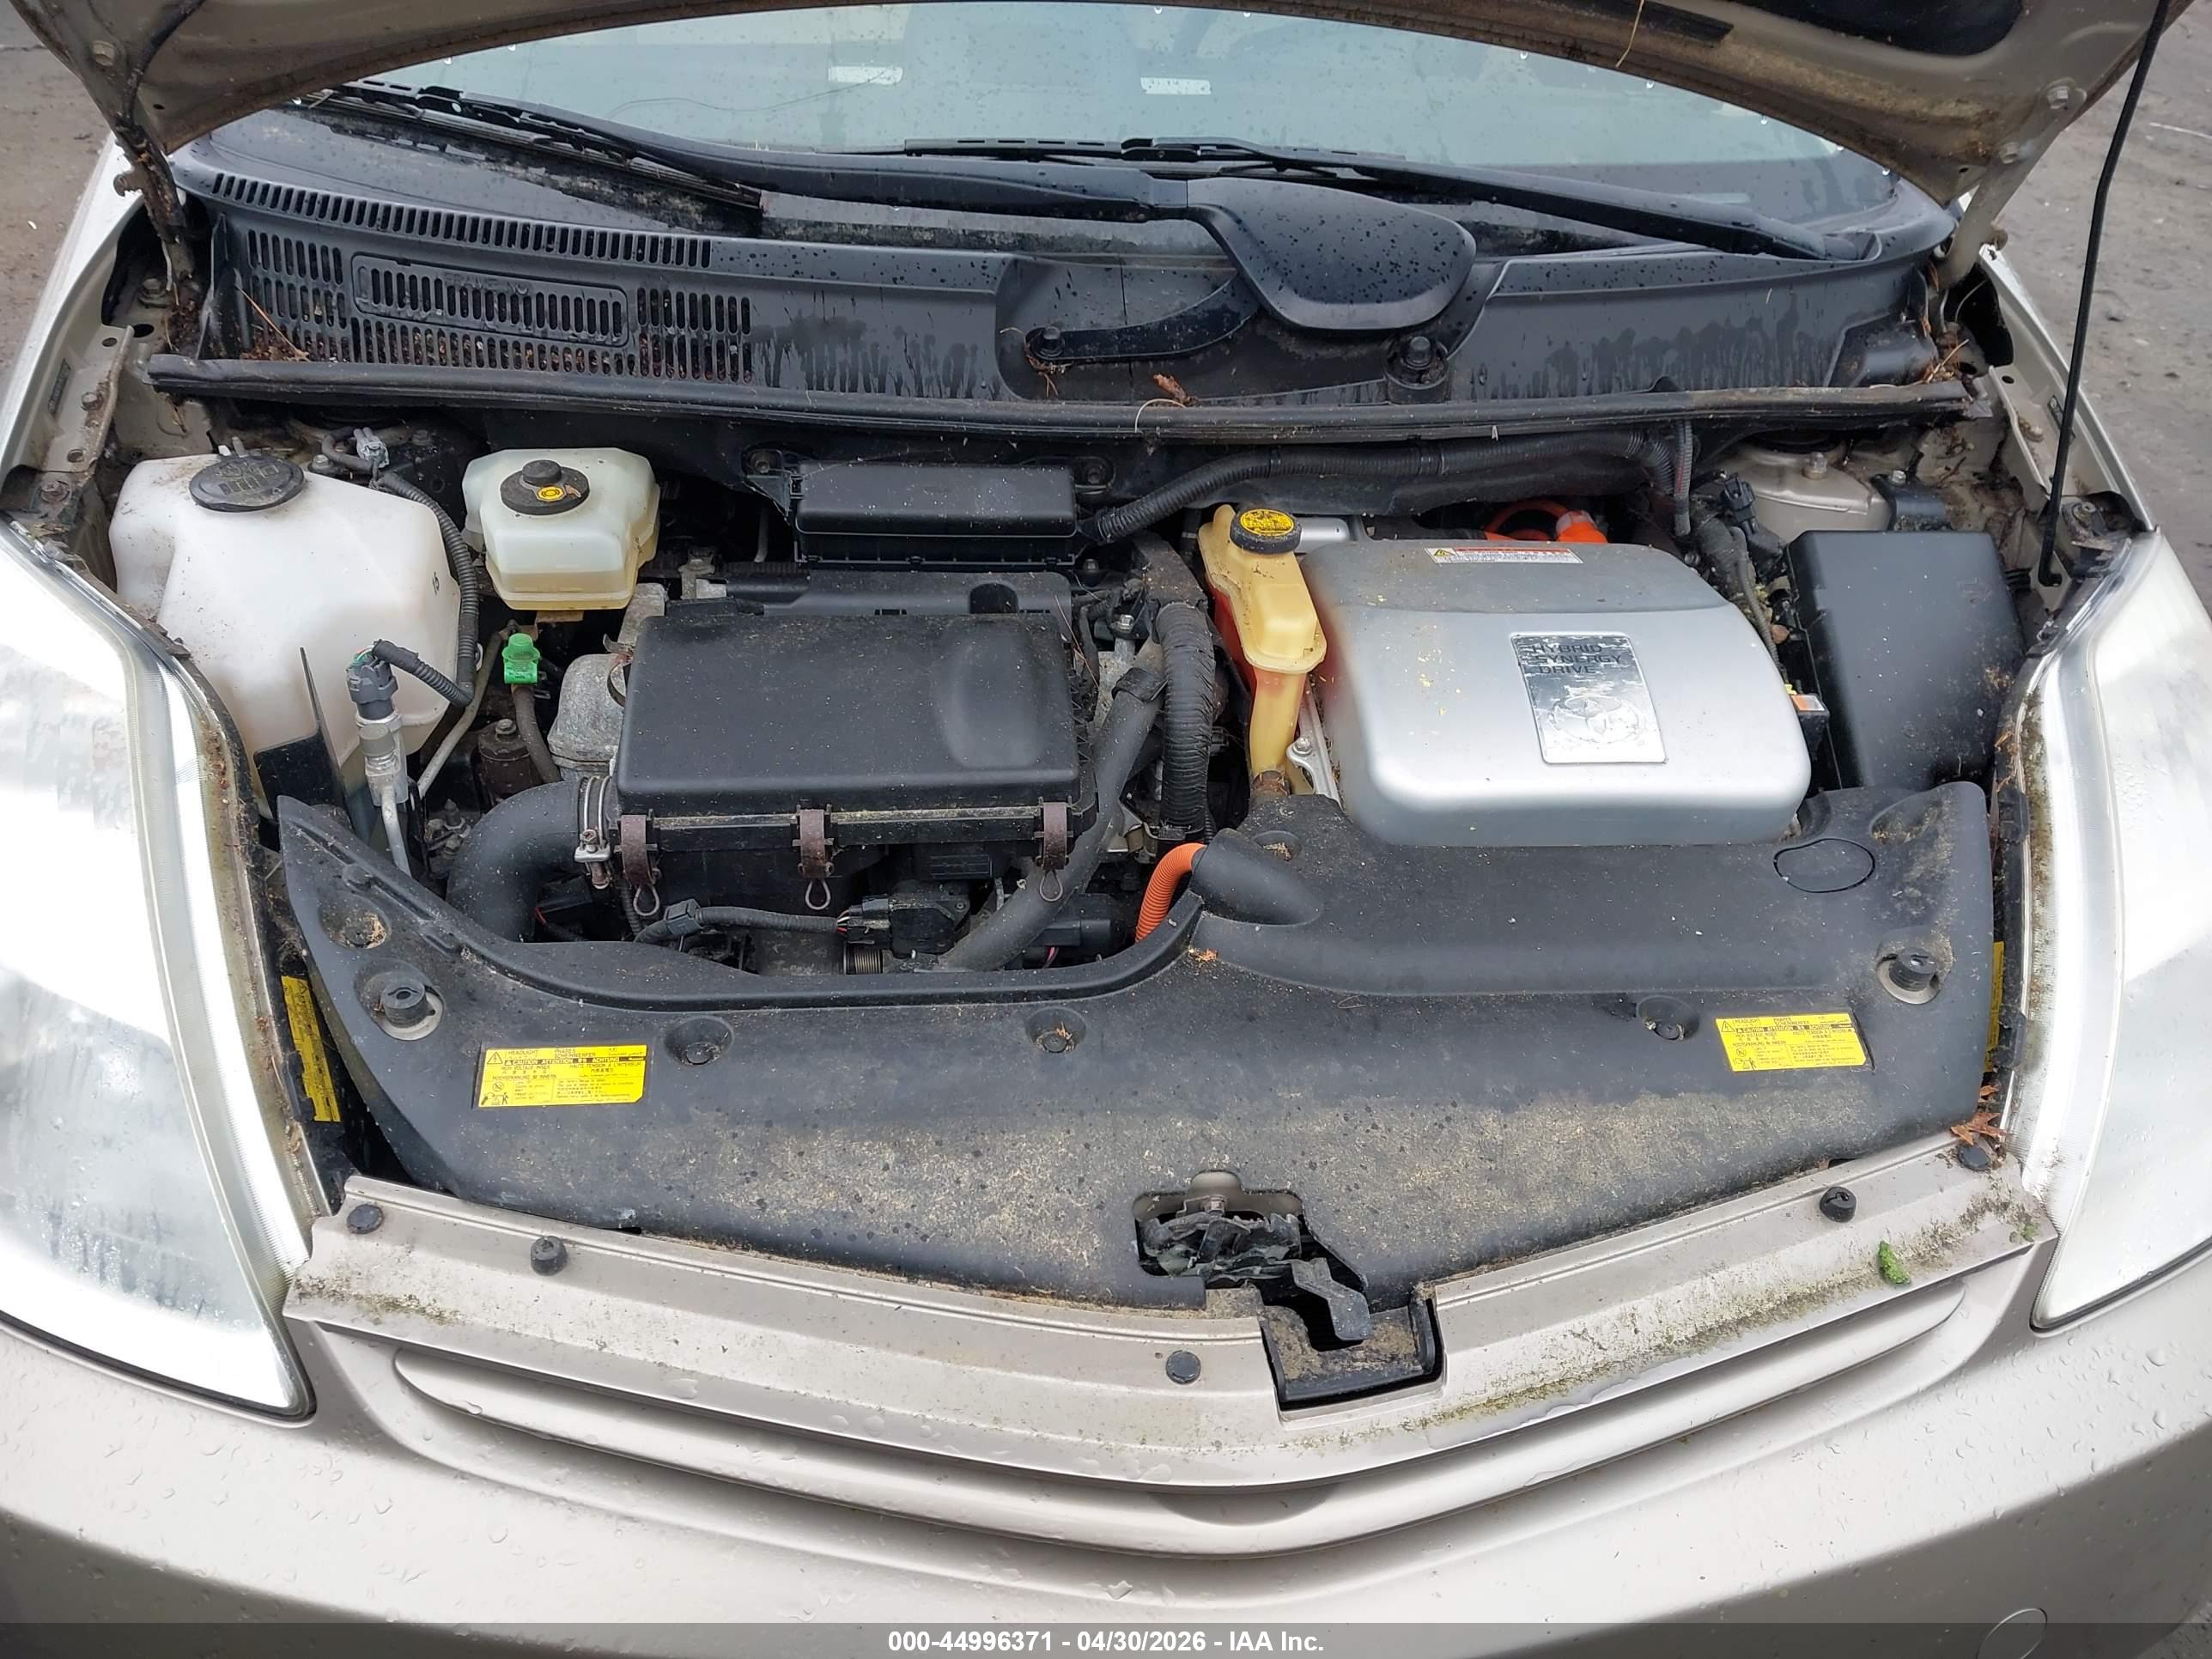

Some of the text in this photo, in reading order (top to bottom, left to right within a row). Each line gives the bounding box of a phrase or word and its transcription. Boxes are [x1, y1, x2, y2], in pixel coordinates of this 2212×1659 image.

[1531, 645, 1603, 653] HYBRID
[1534, 654, 1622, 663] SYNERGY
[1539, 665, 1597, 674] DRIVE
